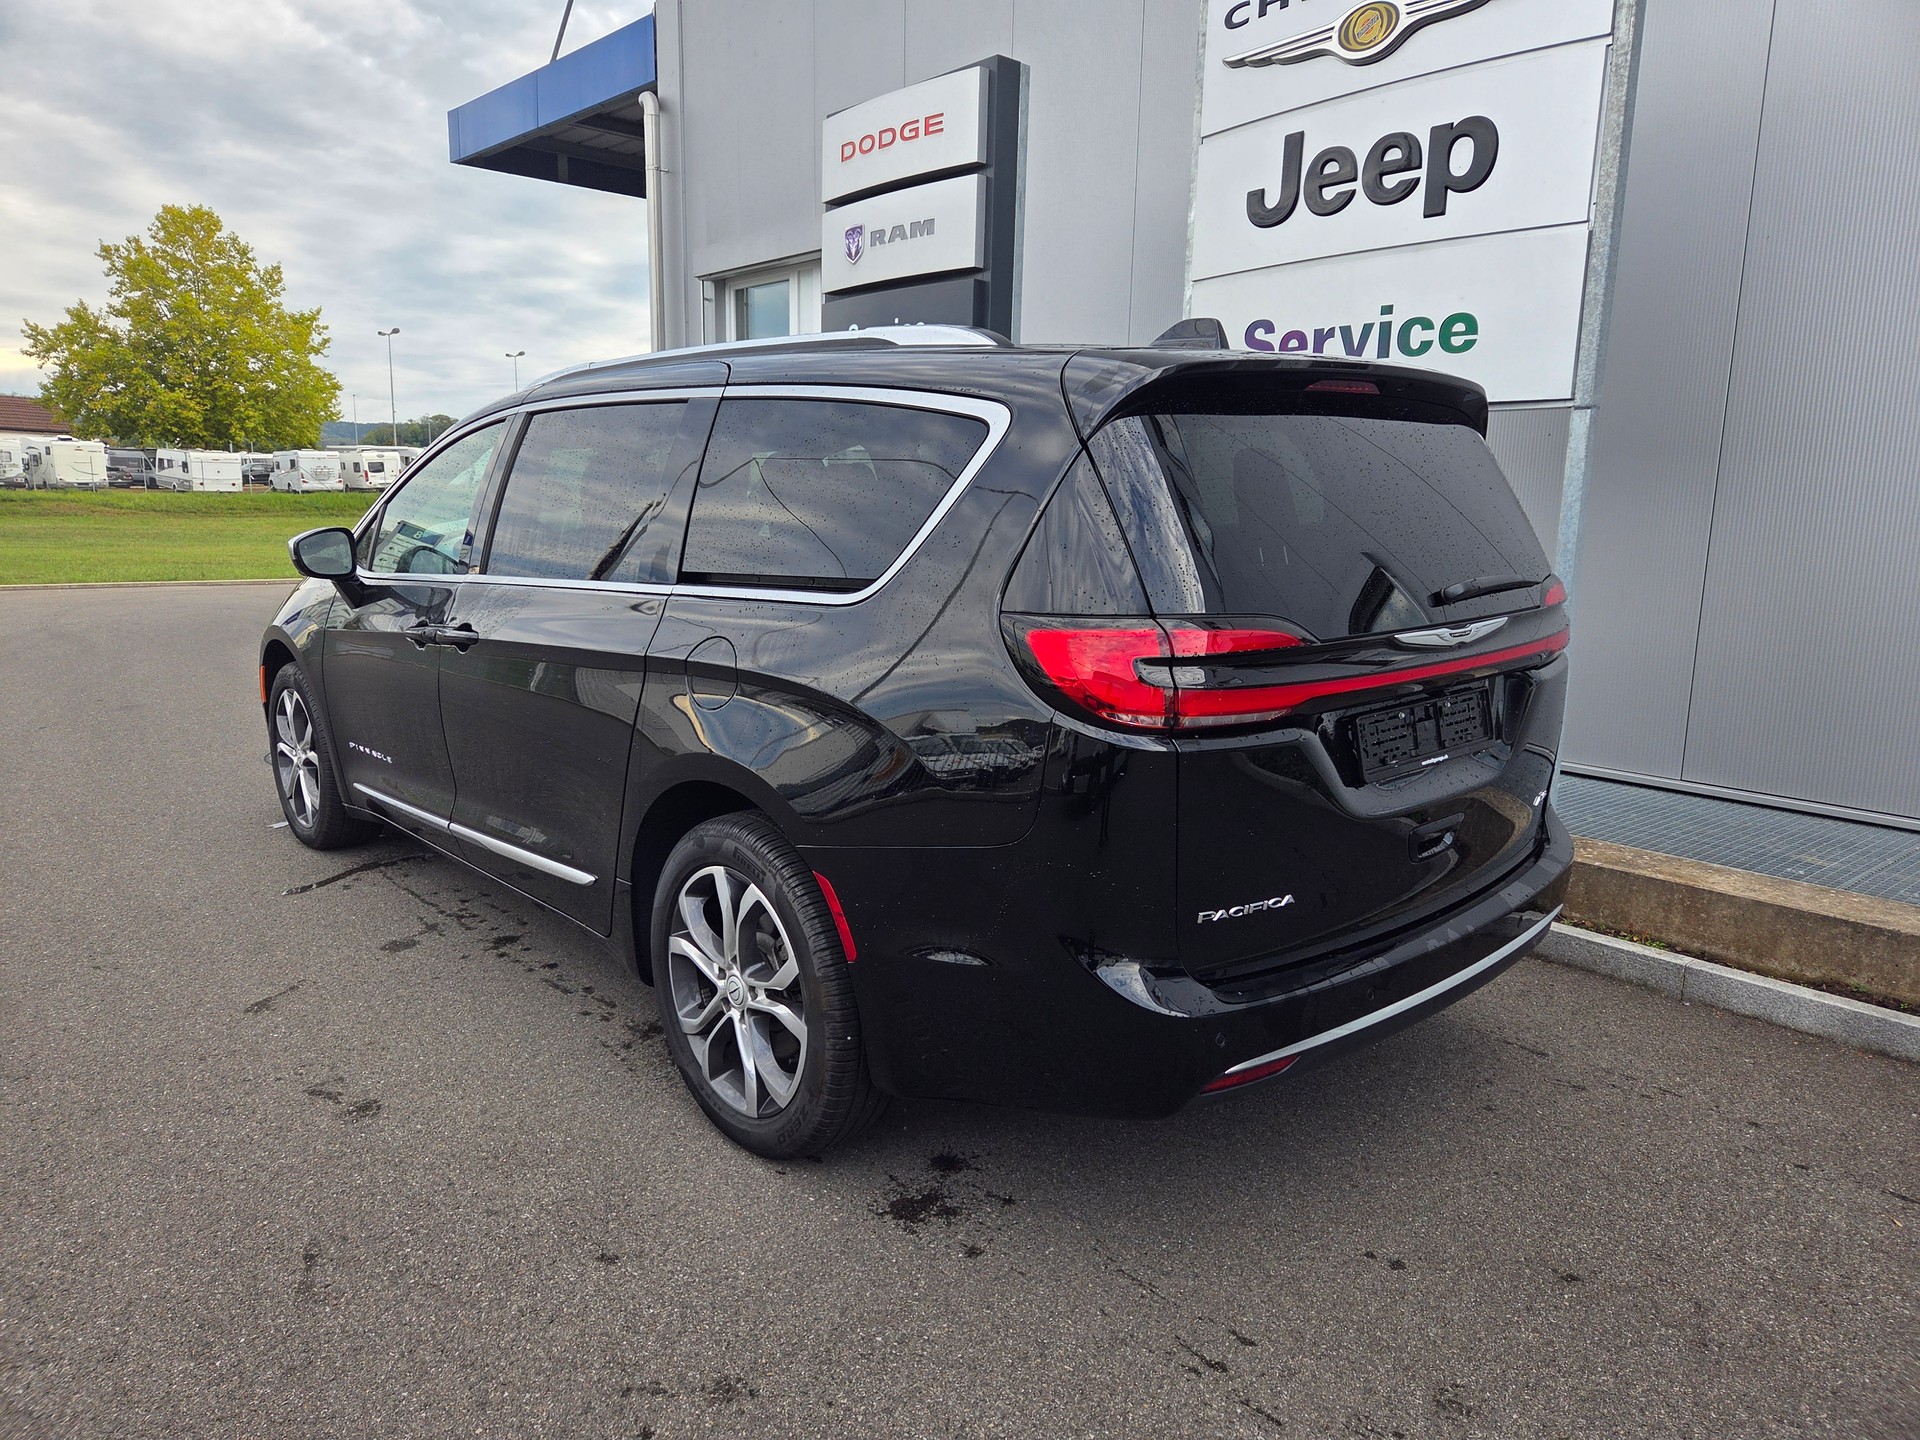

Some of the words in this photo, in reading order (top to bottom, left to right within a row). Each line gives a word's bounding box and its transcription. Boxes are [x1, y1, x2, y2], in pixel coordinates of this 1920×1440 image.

[841, 112, 945, 163] DODGE
[1246, 115, 1500, 228] Jeep
[869, 217, 936, 248] RAM
[1244, 304, 1479, 359] Service
[1196, 894, 1296, 924] PACIFICA
